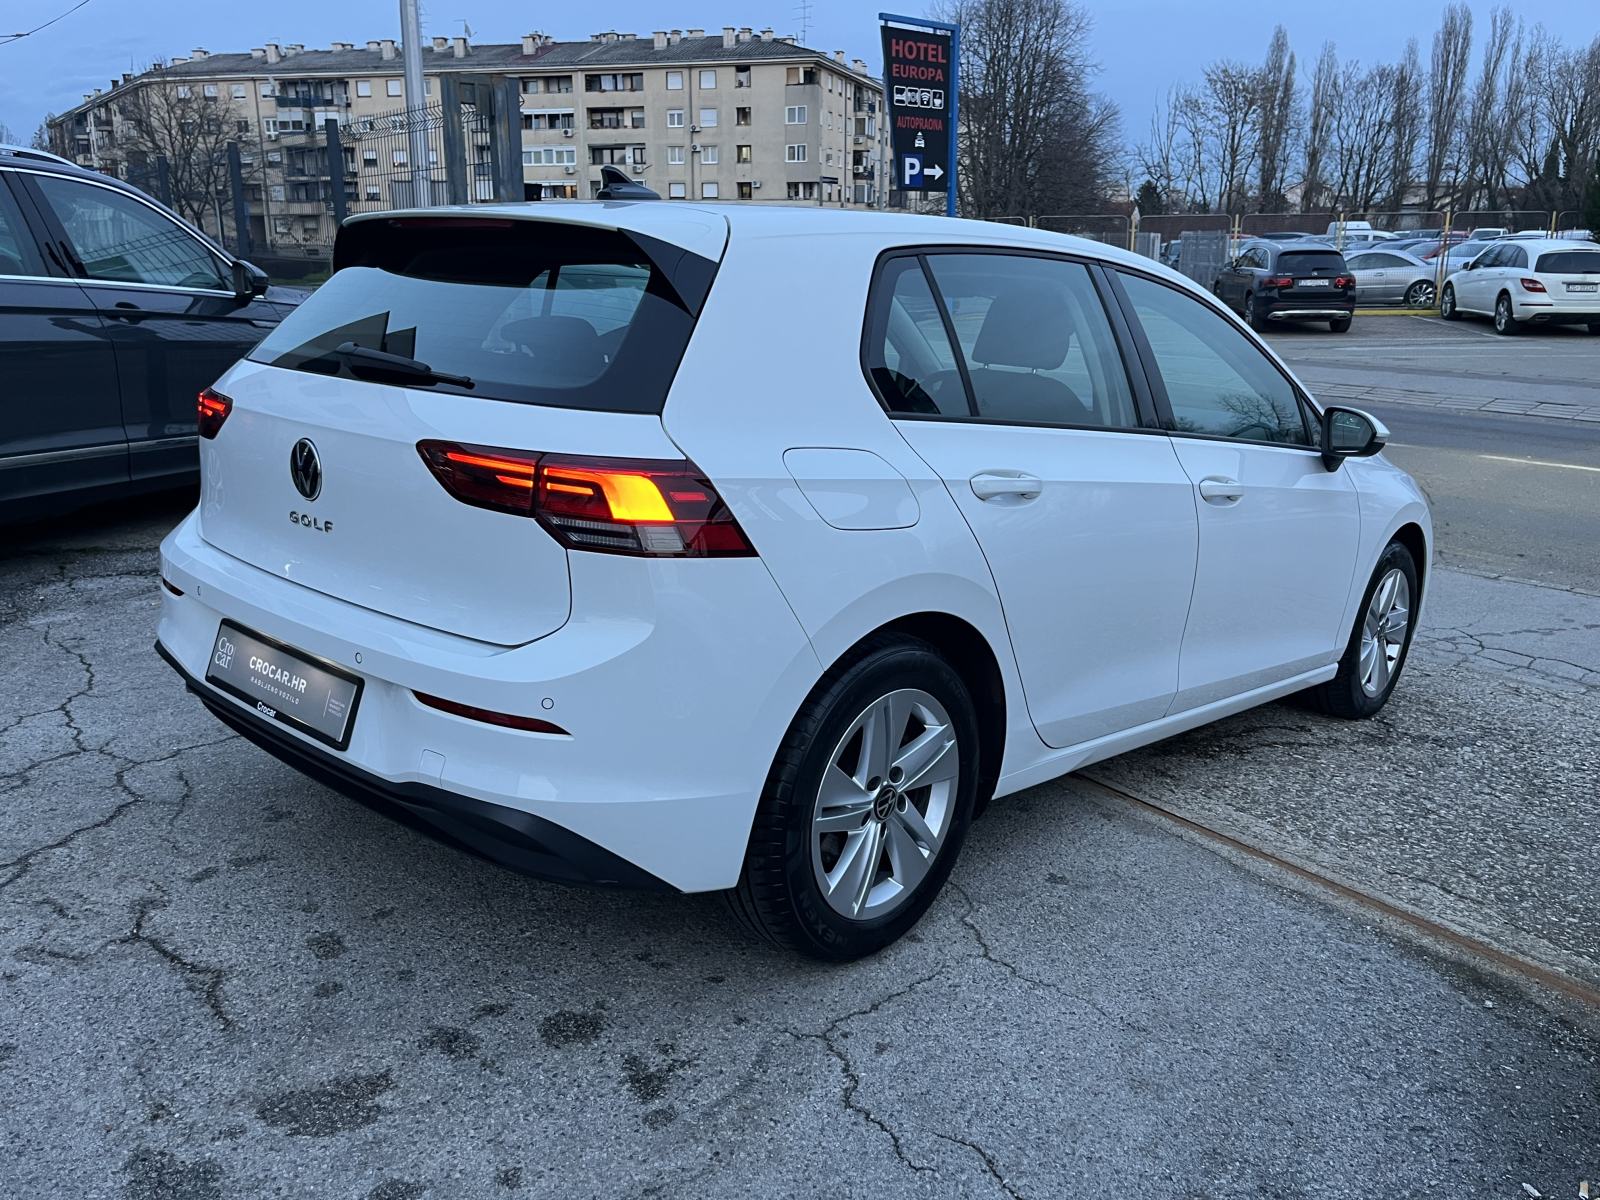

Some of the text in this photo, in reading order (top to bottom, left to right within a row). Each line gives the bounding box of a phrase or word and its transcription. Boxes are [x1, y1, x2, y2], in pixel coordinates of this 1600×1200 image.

[891, 38, 947, 64] HOTEL
[892, 63, 944, 82] EUROPA
[904, 157, 921, 185] P
[289, 510, 334, 533] GOLF
[218, 636, 234, 655] Cro
[214, 652, 232, 670] car
[249, 655, 307, 694] CROCAR.HR
[256, 701, 277, 718] Crocar
